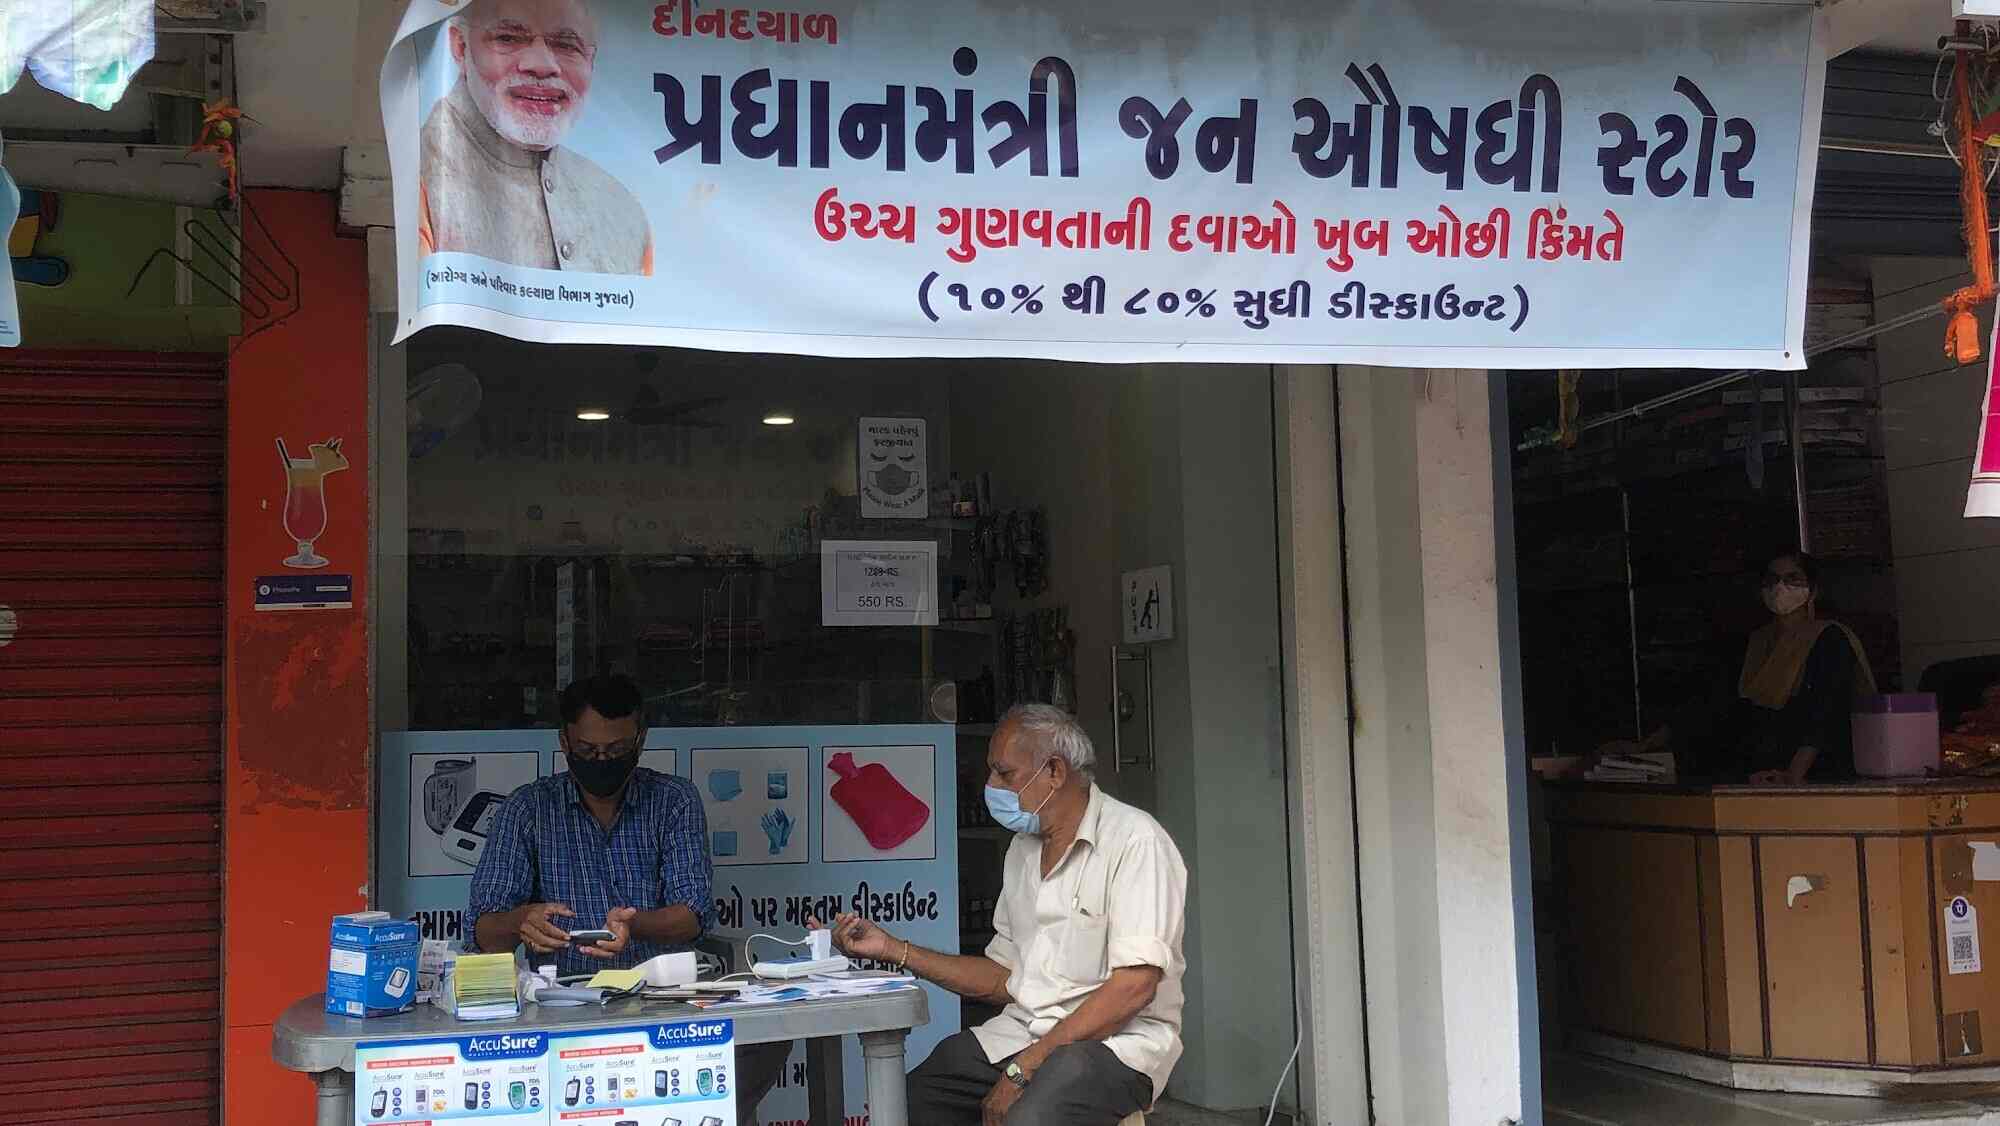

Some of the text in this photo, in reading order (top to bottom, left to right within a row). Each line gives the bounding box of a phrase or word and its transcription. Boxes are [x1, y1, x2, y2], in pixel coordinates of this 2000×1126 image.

[653, 0, 837, 44] દીનદયાળ
[653, 46, 1758, 199] પ્રધાનમંત્રી જન ઔષધી સ્ટોર
[813, 186, 1626, 273] ઉચ્ચ ગુણવતાની દવાઓ ખુબ ઓછી કિંમતે
[470, 271, 488, 288] અને
[1061, 274, 1107, 315] થી
[1123, 286, 1217, 318] ૮૦%
[1232, 279, 1312, 330] સુધી
[1327, 280, 1530, 333] ડીસ્કાઉન્ટ)
[857, 595, 904, 608] 550 RS
[751, 894, 779, 928] પર
